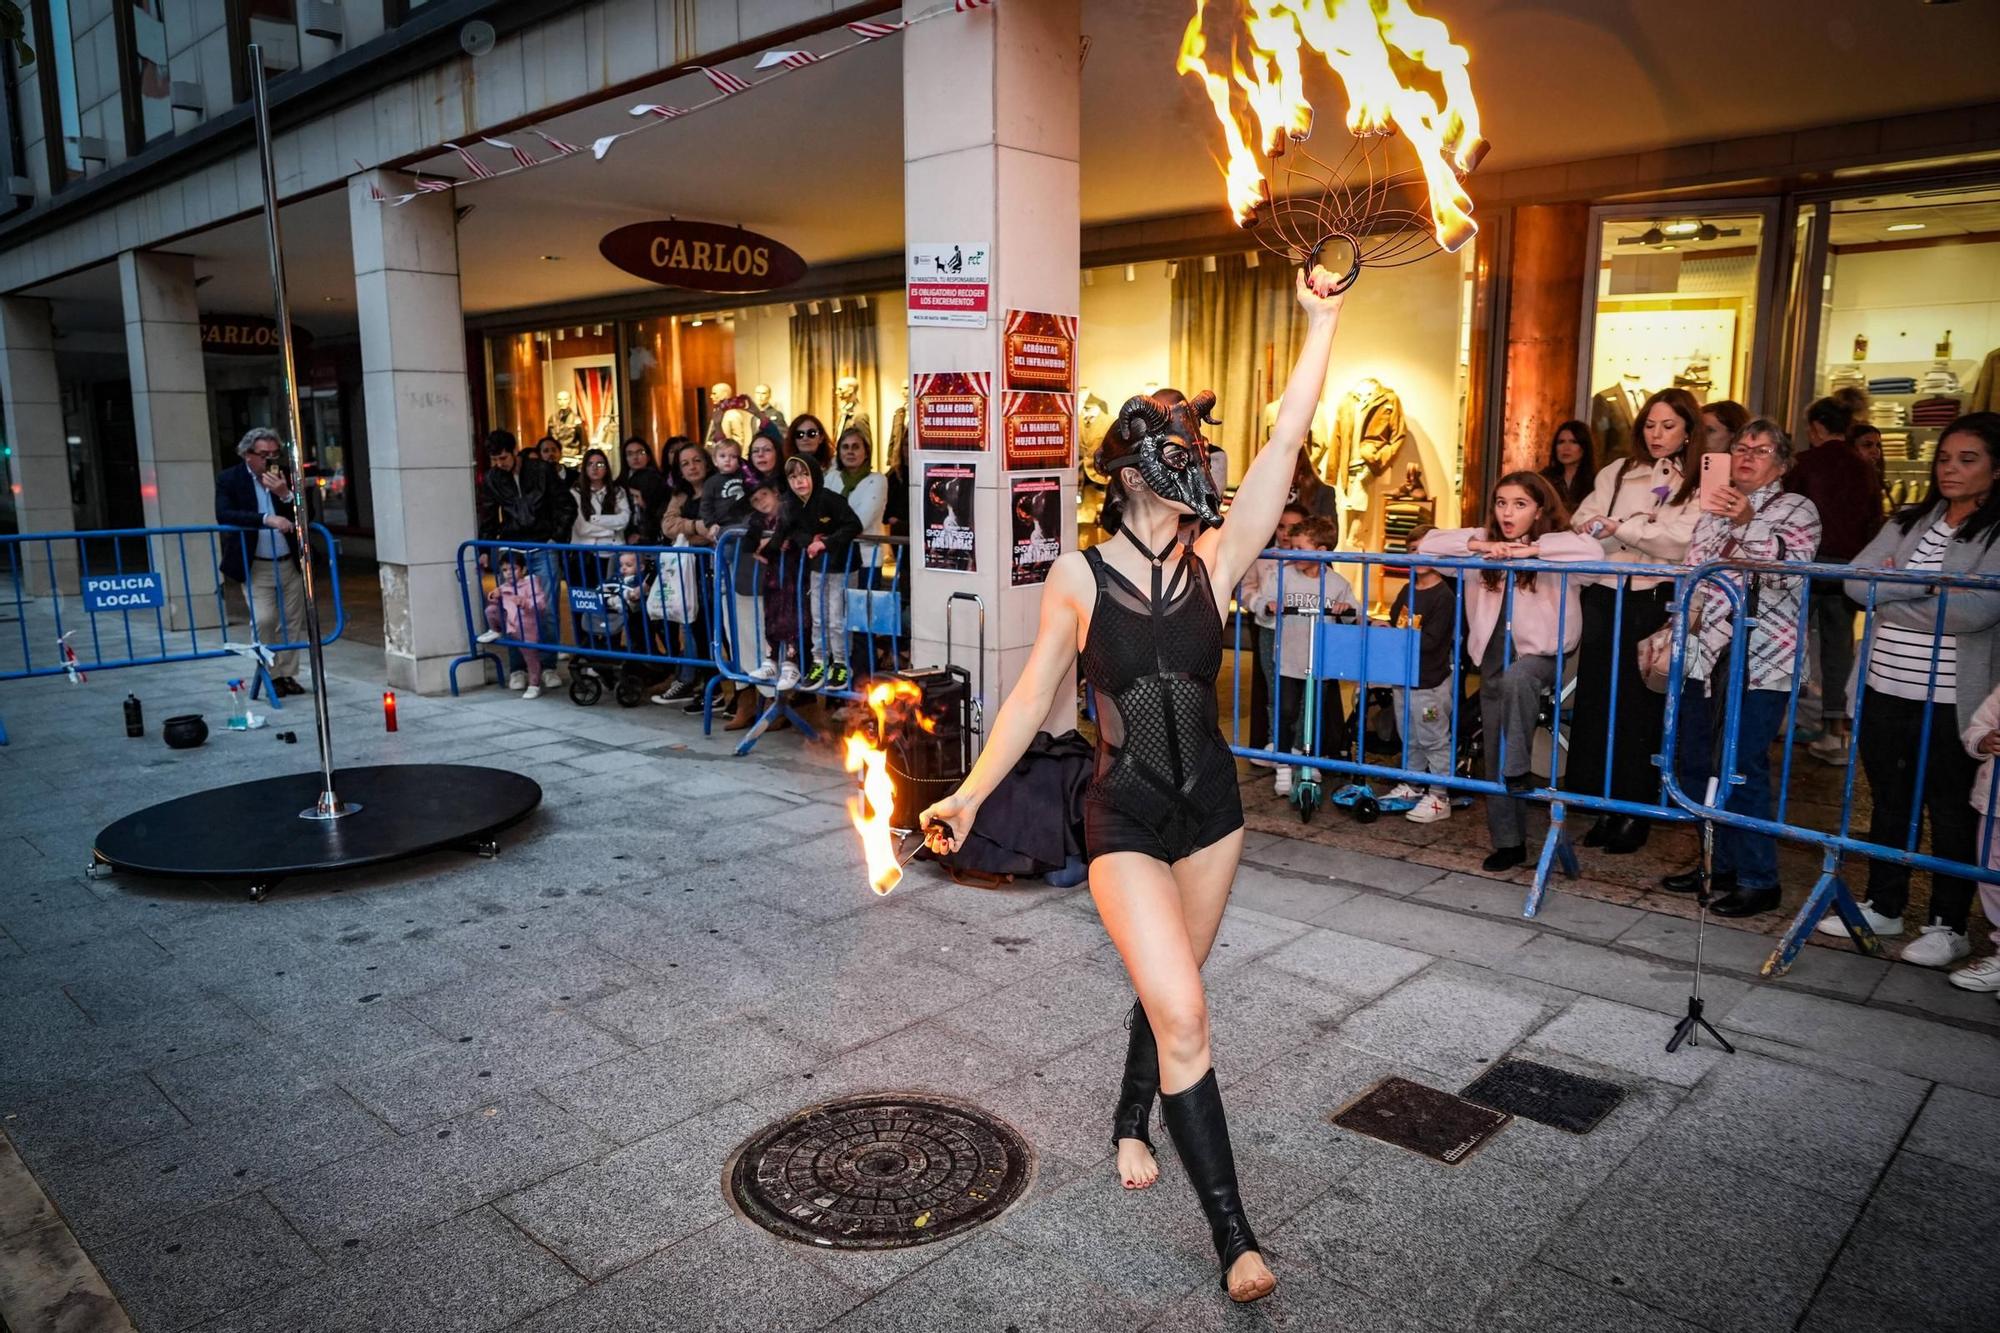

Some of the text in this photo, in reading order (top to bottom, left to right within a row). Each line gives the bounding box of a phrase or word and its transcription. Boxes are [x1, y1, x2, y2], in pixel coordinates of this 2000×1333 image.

[650, 236, 769, 277] CARLOS
[911, 288, 985, 298] ES OBLIGATORIO RECOGER
[920, 297, 975, 306] LOS EXCREMENTOS
[1023, 343, 1058, 355] ACRÓBATAS
[1014, 356, 1066, 369] DEL INFRAMUNDO
[928, 404, 974, 413] EL GRAN CIRCO
[924, 417, 979, 427] DE LOS HORRORES
[1020, 423, 1028, 432] LA
[1015, 435, 1064, 446] MUJER DE FUEGO
[88, 577, 155, 592] POLICIA
[571, 590, 597, 599] POLICIA
[96, 593, 151, 607] LOCAL
[575, 601, 598, 610] LOCAL
